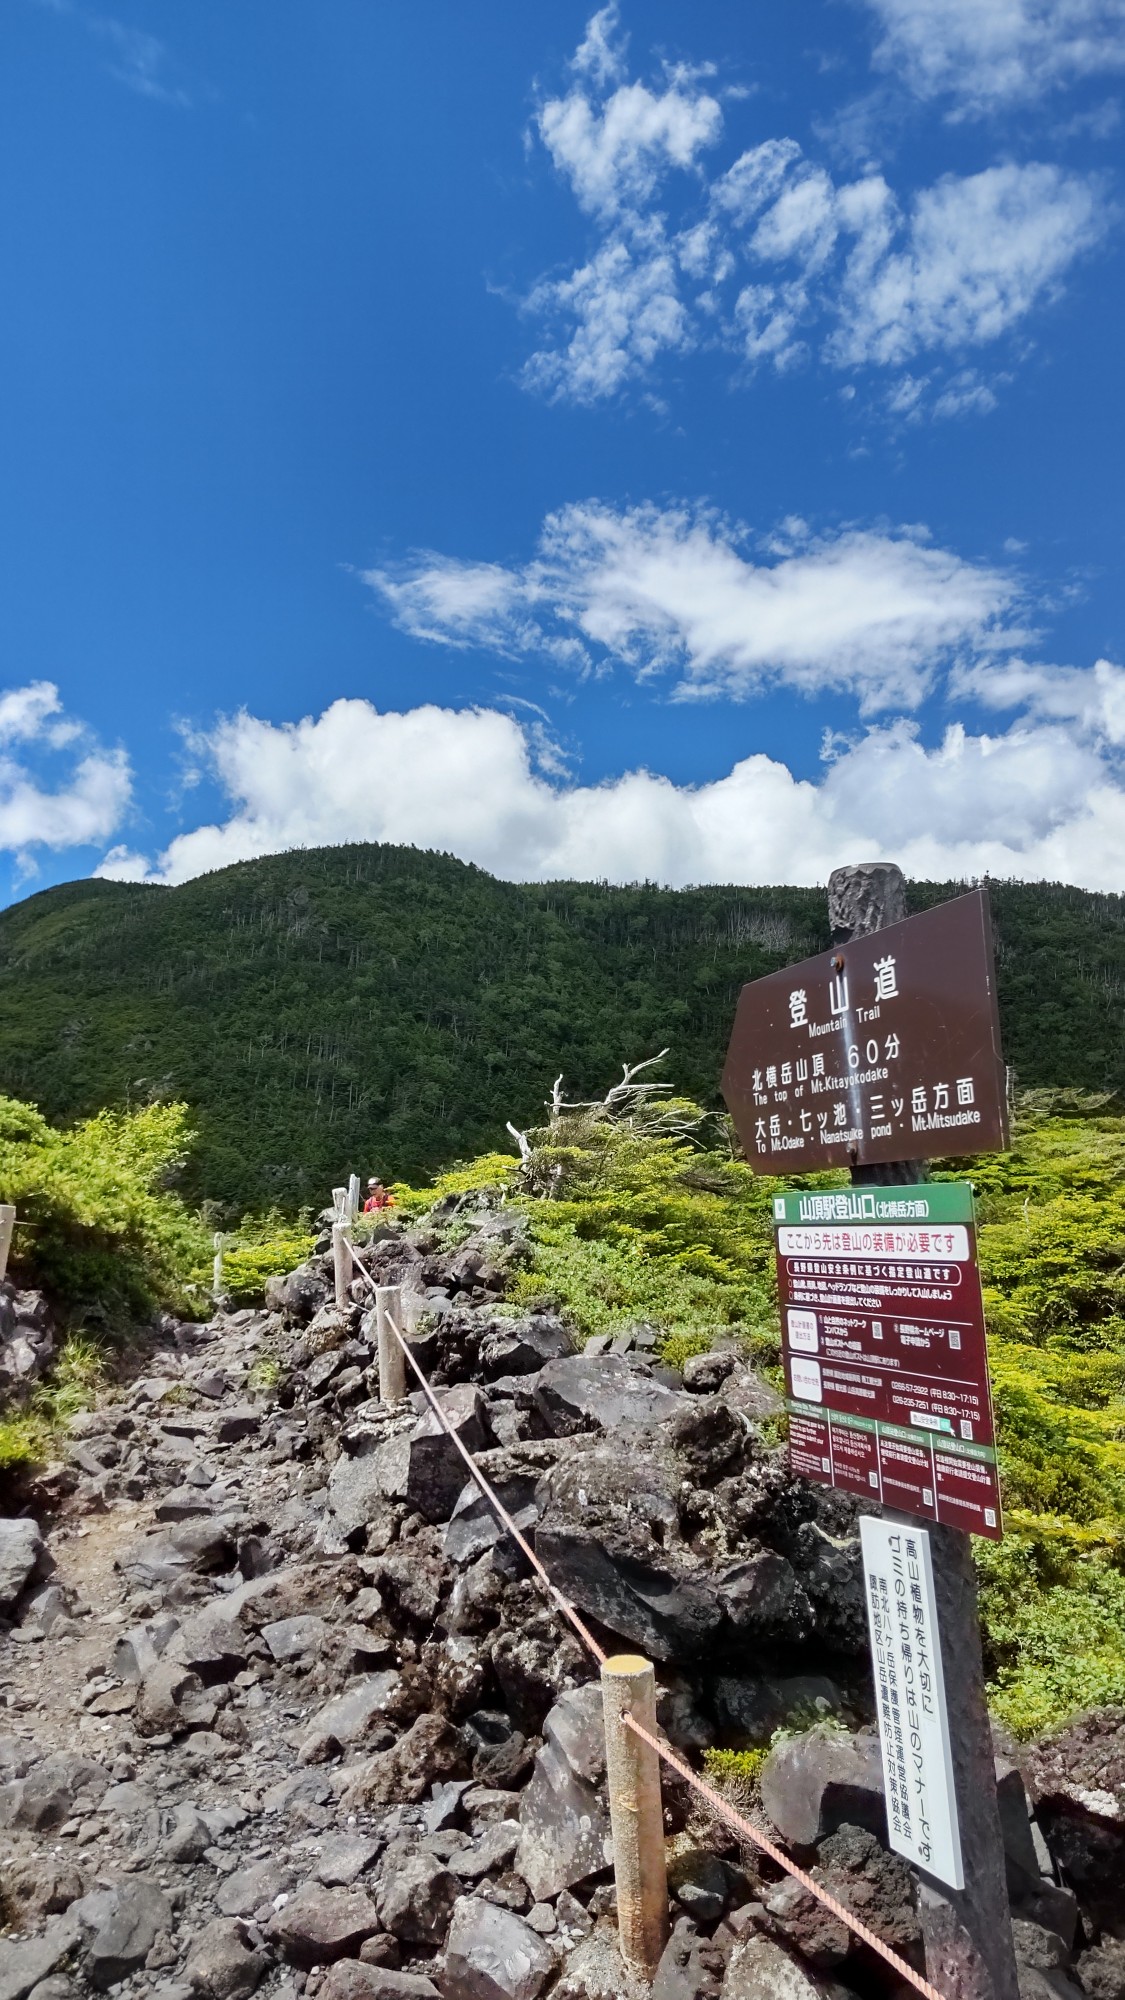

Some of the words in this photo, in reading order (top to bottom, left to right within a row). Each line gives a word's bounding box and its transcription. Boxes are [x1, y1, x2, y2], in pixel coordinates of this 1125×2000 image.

[789, 955, 899, 1028] 登山道
[808, 1016, 847, 1038] Mountain
[856, 1005, 881, 1023] Trail
[752, 1053, 825, 1091] 北横岳山頂
[848, 1033, 900, 1069] 60分
[753, 1093, 767, 1106] The
[774, 1090, 787, 1102] top
[794, 1086, 804, 1097] of
[756, 1139, 766, 1153] To
[771, 1134, 805, 1152] Mt.Odake
[820, 1128, 863, 1145] Nanatsuike
[870, 1125, 892, 1139] pond
[911, 1109, 981, 1132] Mt.Mitsudake
[787, 1233, 955, 1253] ここから先は登山の装備が必要です
[905, 1539, 934, 1715] 高山植物を大切に
[890, 1535, 932, 1862] ゴミの持ち帰りは山のマナーです
